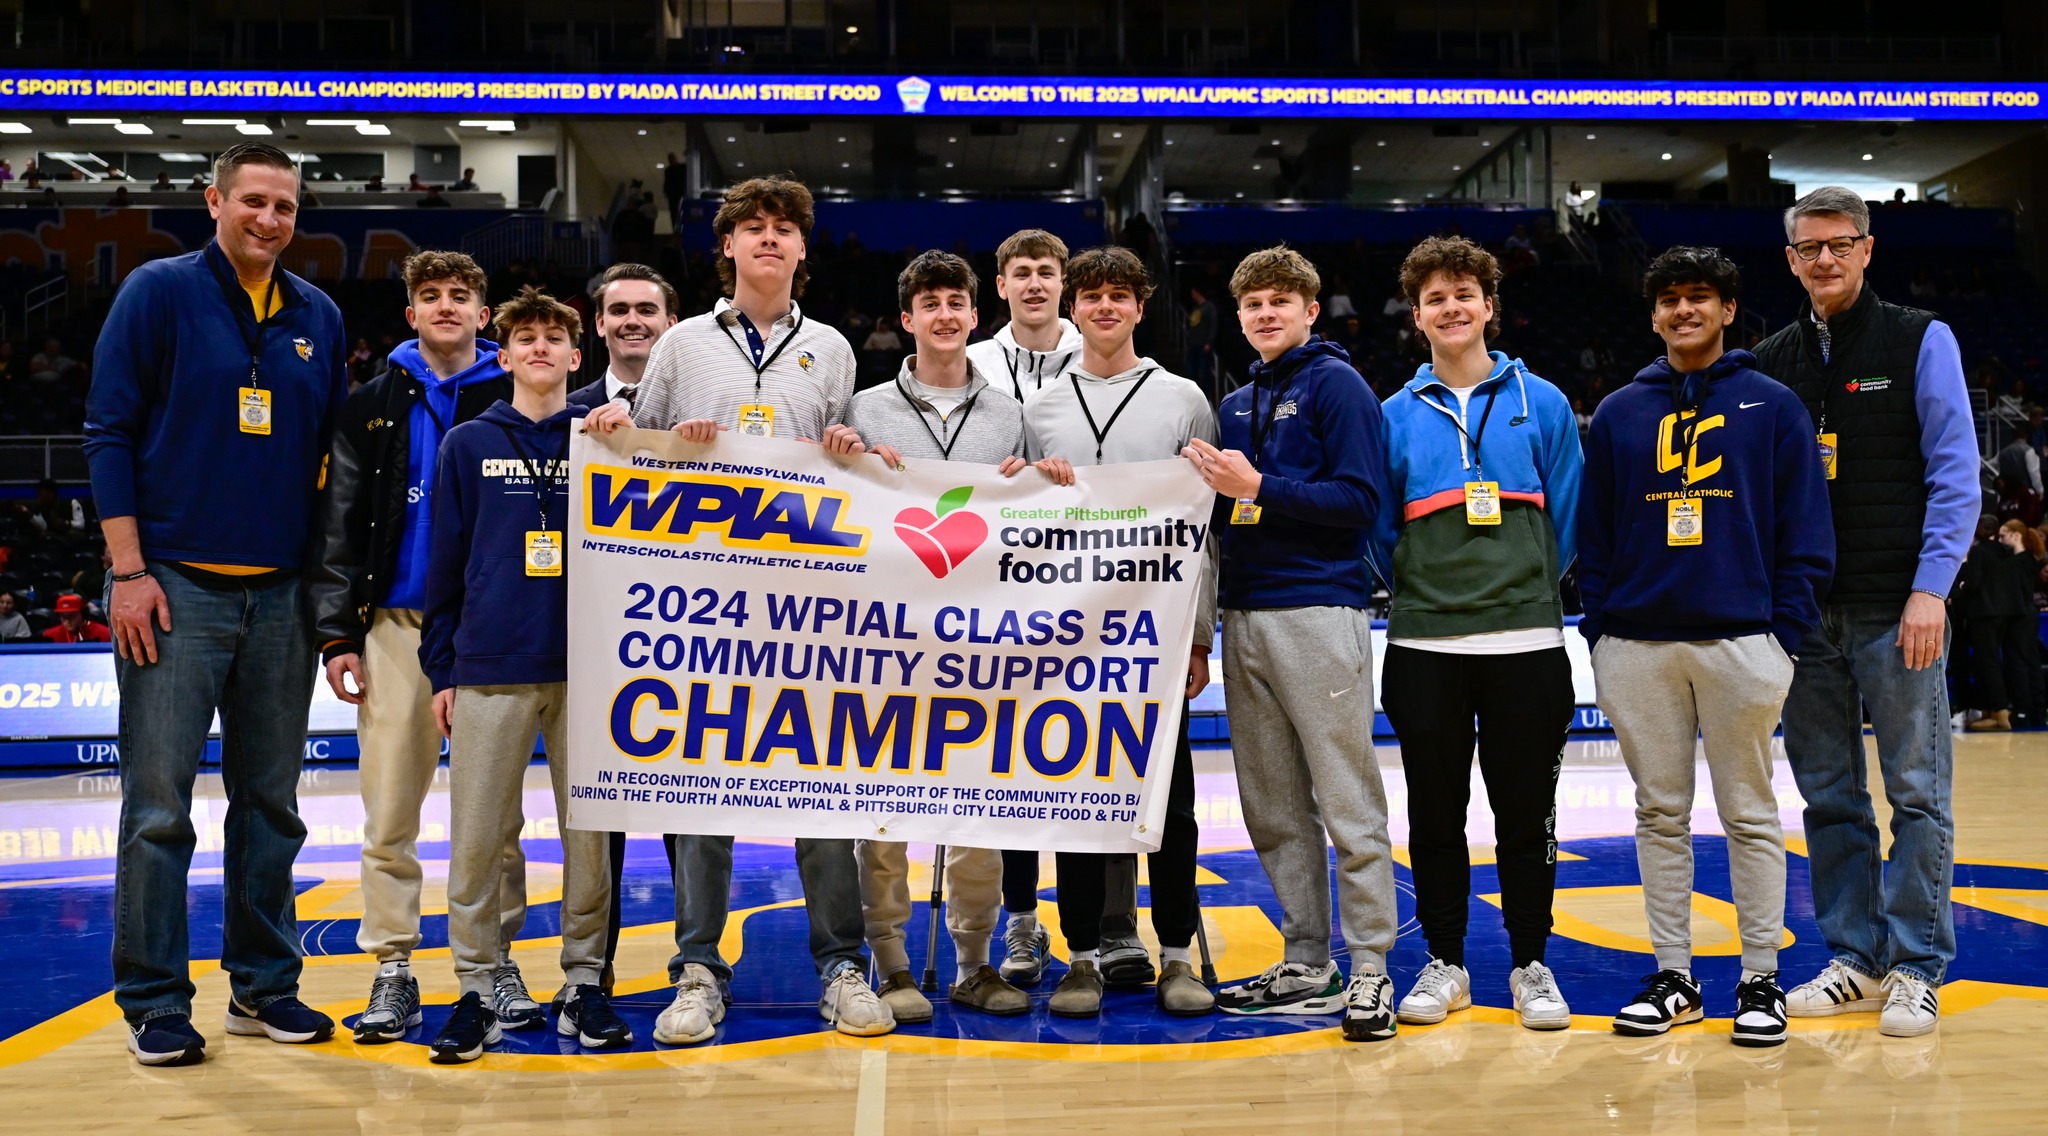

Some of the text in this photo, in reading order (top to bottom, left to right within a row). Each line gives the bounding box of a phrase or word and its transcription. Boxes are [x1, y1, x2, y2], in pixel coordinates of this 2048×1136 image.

[17, 79, 92, 95] SPORTS
[97, 80, 186, 96] MEDICINE
[190, 81, 316, 97] BASKETBALL
[319, 81, 475, 98] CHAMPIONSHIPS
[478, 83, 585, 99] PRESENTED
[588, 84, 614, 99] BY
[618, 84, 678, 99] PIADA
[682, 84, 756, 100] ITALIAN
[759, 84, 826, 100] STREET
[829, 85, 880, 100] FOOD
[940, 86, 2039, 106] WELCOME TO THE 2025 WPIAL/UPMC SPORTS MEDICINE BASKETBALL CHAMPIONSHIPS PRESENTED BY PIADA ITALIAN STREET FOOD
[632, 455, 826, 485] WESTERN PENNSYLVANIA
[591, 472, 863, 547] WPIAL
[1646, 489, 1734, 501] CENTRAL CATHOLIC
[1000, 506, 1148, 522] Greater Pittsburgh
[1000, 517, 1207, 553] community
[582, 539, 867, 573] INTERSCHOLASTIC ATHLETIC LEAGUE
[999, 553, 1183, 584] food bank
[624, 582, 1159, 646] 2024 WPIAL CLASS 5A
[618, 631, 1159, 693] COMMUNITY SUPPORT
[608, 675, 1162, 783] CHAMPION
[571, 785, 617, 800] DURING
[622, 789, 652, 802] THE
[656, 790, 717, 806] FOURTH
[721, 794, 782, 809] ANNUAL
[787, 797, 835, 811] WPIAL
[838, 799, 851, 811] &
[855, 800, 948, 815] PITTSBURGH
[953, 804, 985, 817] CITY
[989, 805, 1047, 820] LEAGUE
[1051, 807, 1091, 821] FOOD
[1095, 809, 1107, 822] &
[598, 770, 612, 783] IN
[617, 772, 721, 789] RECOGNITION
[725, 777, 746, 790] OF
[750, 779, 851, 795] EXCEPTIONAL
[855, 784, 925, 798] SUPPORT
[929, 786, 949, 799] OF
[953, 787, 980, 800] THE
[984, 789, 1077, 805] COMMUNITY
[1081, 792, 1121, 805] FOOD
